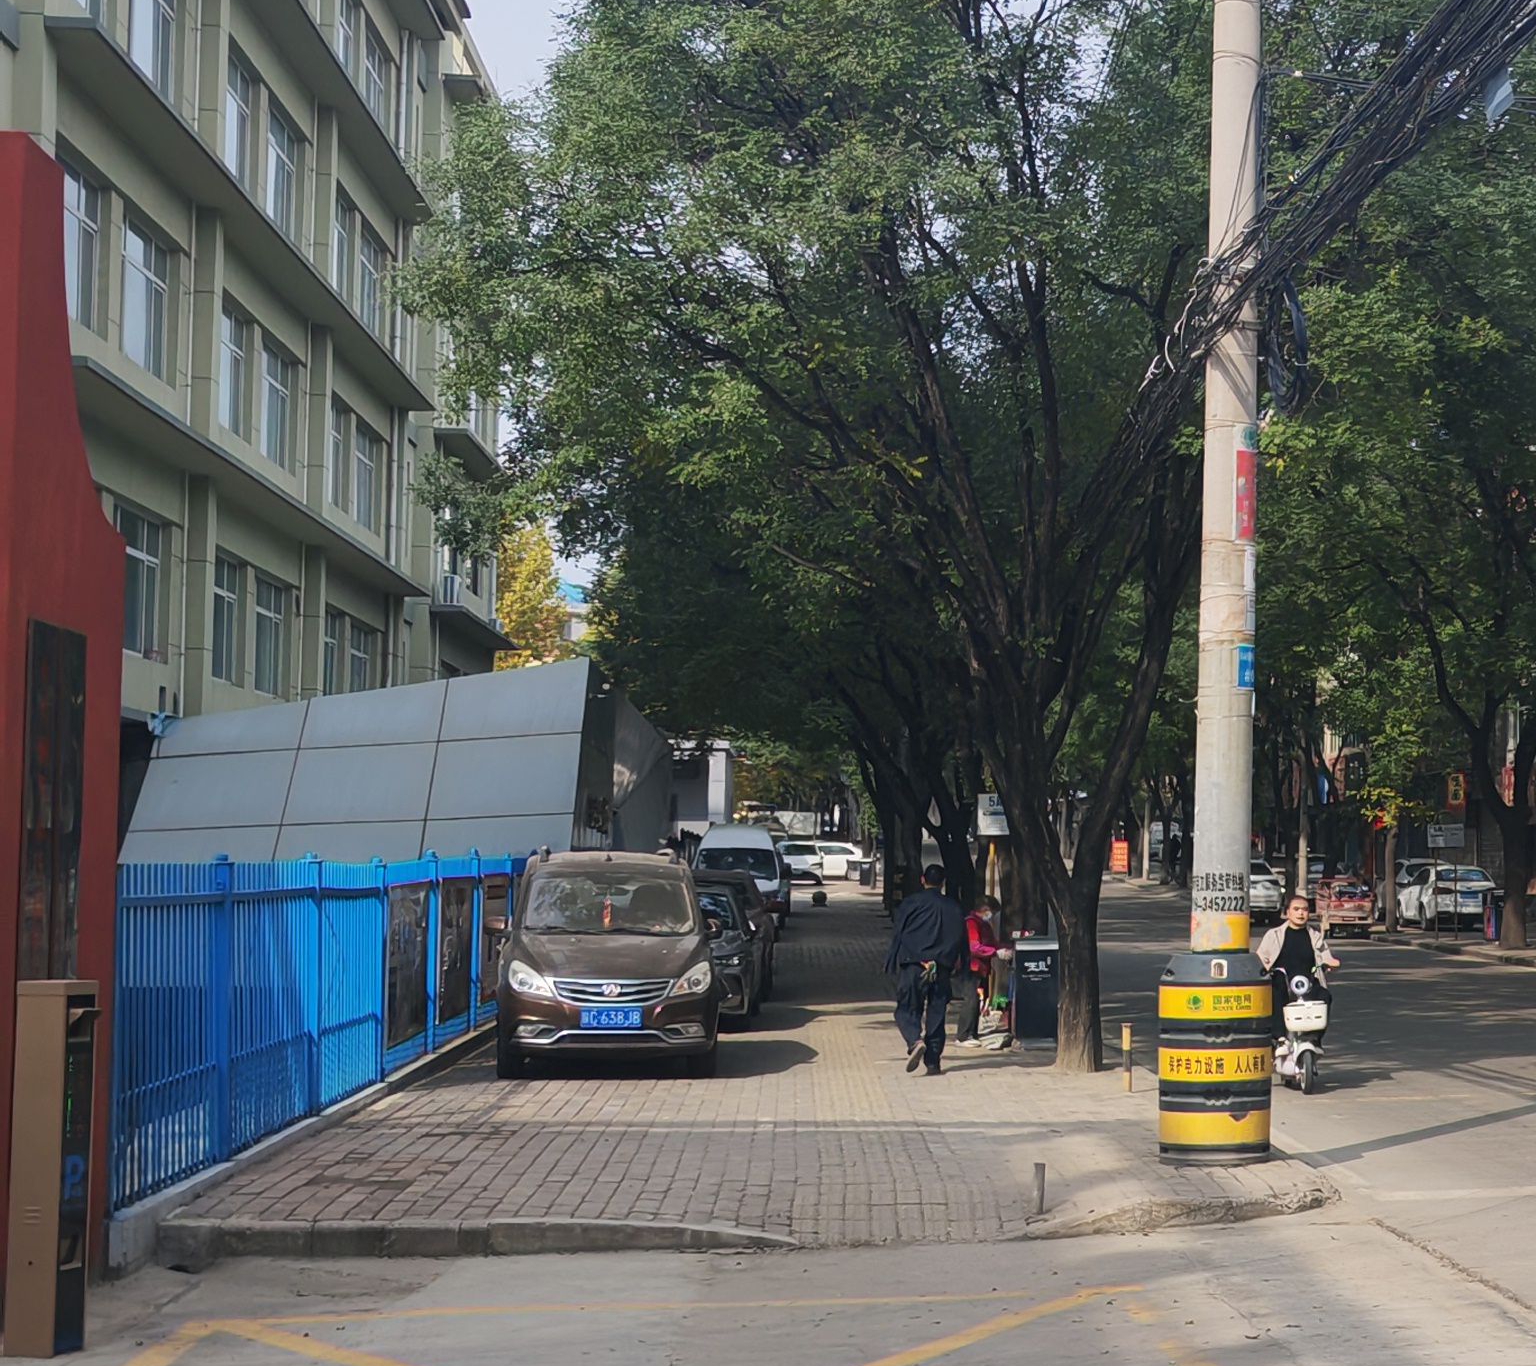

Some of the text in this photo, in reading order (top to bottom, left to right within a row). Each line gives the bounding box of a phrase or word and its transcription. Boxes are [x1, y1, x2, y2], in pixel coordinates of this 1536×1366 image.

[1212, 993, 1252, 1005] 国家电网
[63, 1154, 85, 1201] P
